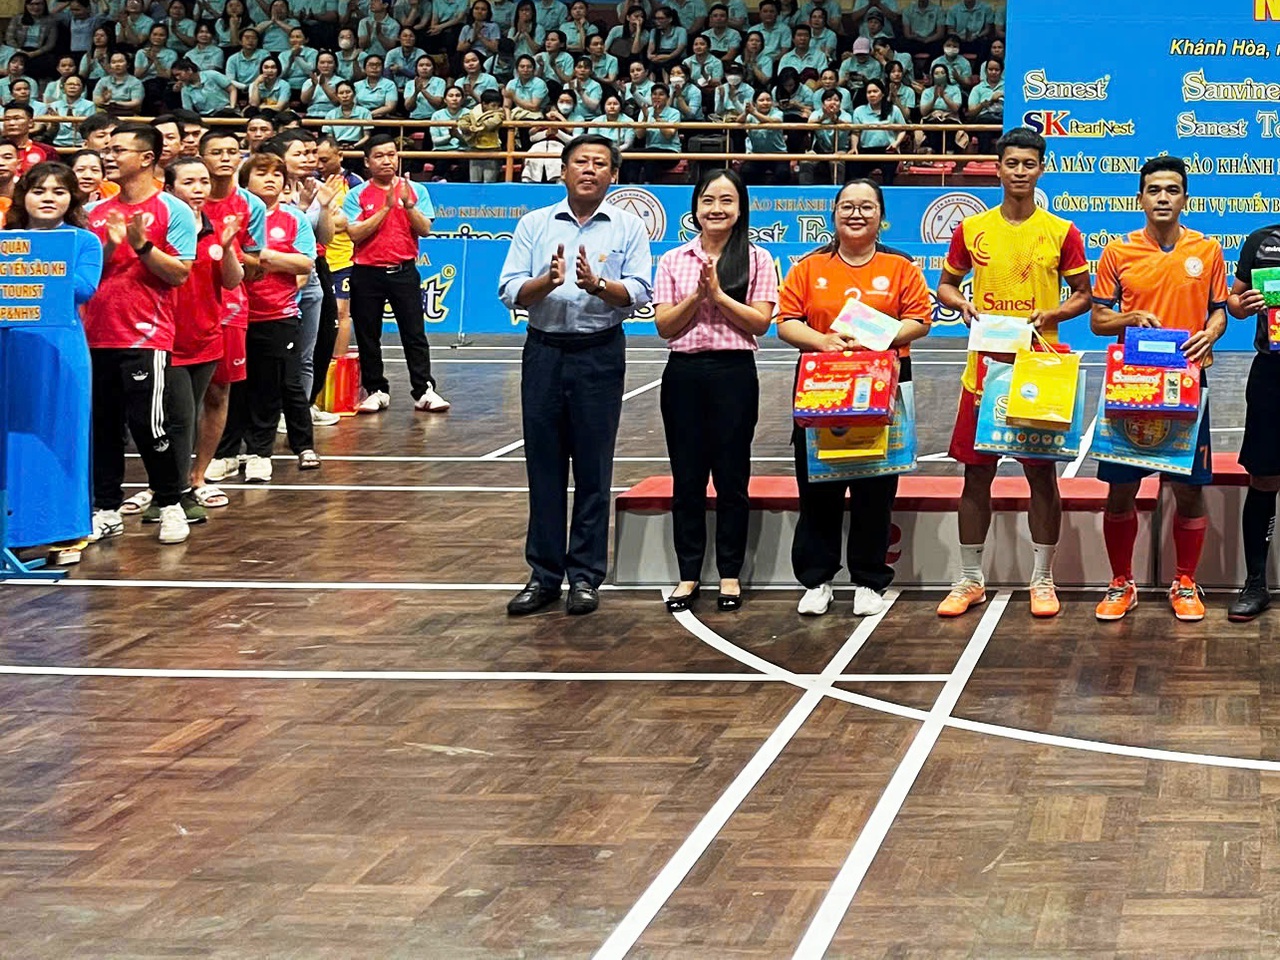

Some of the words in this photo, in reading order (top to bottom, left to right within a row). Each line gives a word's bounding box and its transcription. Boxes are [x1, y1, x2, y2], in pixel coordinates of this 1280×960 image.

[1168, 38, 1227, 57] Khánh
[1231, 38, 1271, 59] Hòa,
[1023, 68, 1110, 102] Sanest
[1022, 110, 1071, 137] SK
[1176, 110, 1249, 139] Sanest
[1060, 151, 1097, 174] MÁY
[1216, 153, 1275, 175] KHÁNH
[1053, 192, 1088, 212] CÔNG
[1090, 195, 1107, 213] TY
[1182, 196, 1206, 217] ỊCH
[1208, 196, 1227, 217] VỤ
[1228, 192, 1270, 214] TUYẾN
[983, 292, 1036, 311] Sanest
